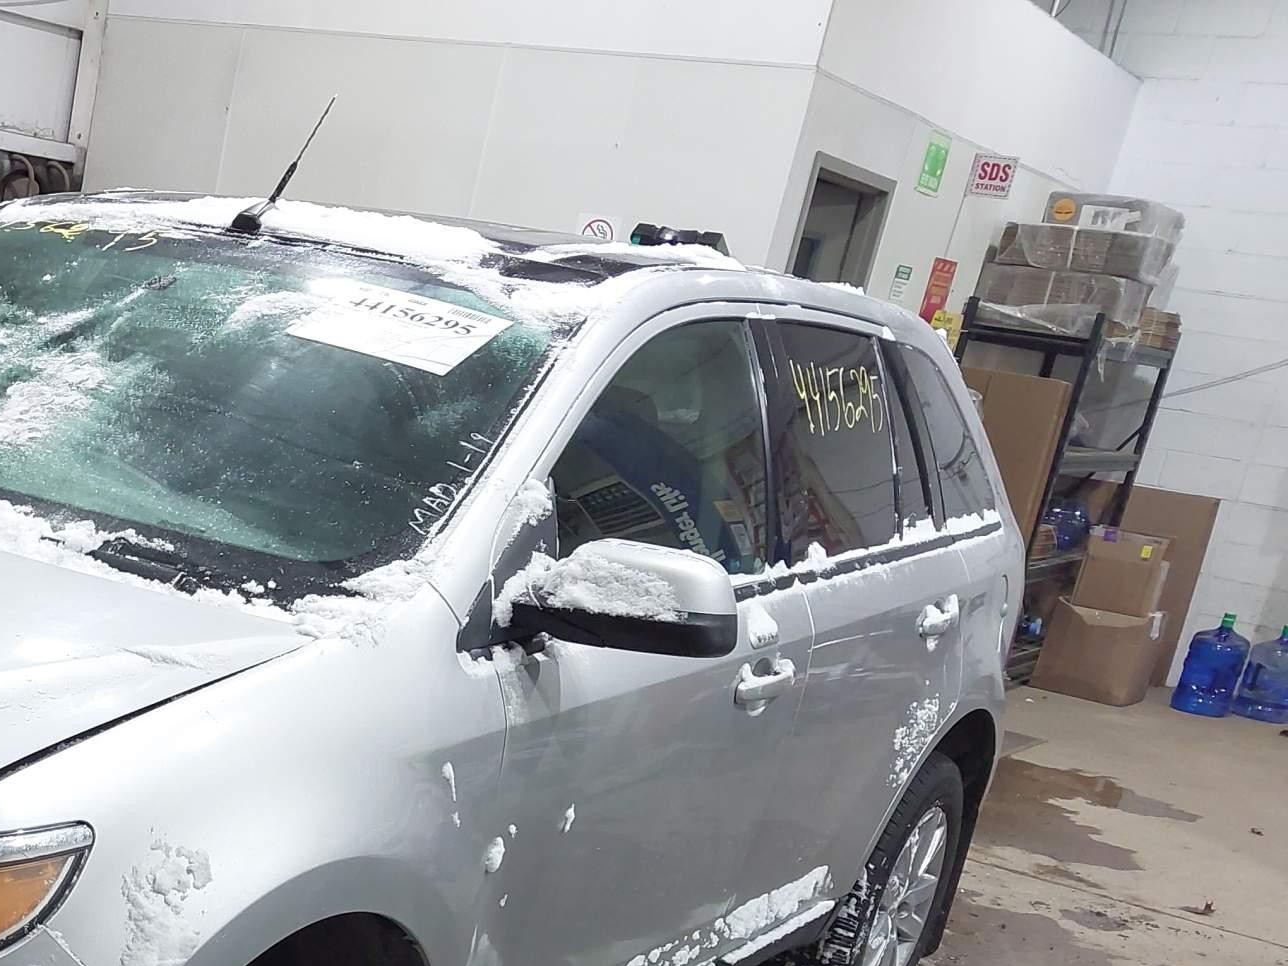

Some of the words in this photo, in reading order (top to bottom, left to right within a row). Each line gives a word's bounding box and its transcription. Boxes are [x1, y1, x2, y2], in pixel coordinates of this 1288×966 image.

[974, 182, 1007, 193] STATION
[978, 161, 1012, 183] SDS
[349, 297, 478, 336] 44156295
[789, 359, 883, 437] 44156295
[408, 482, 457, 536] MAD
